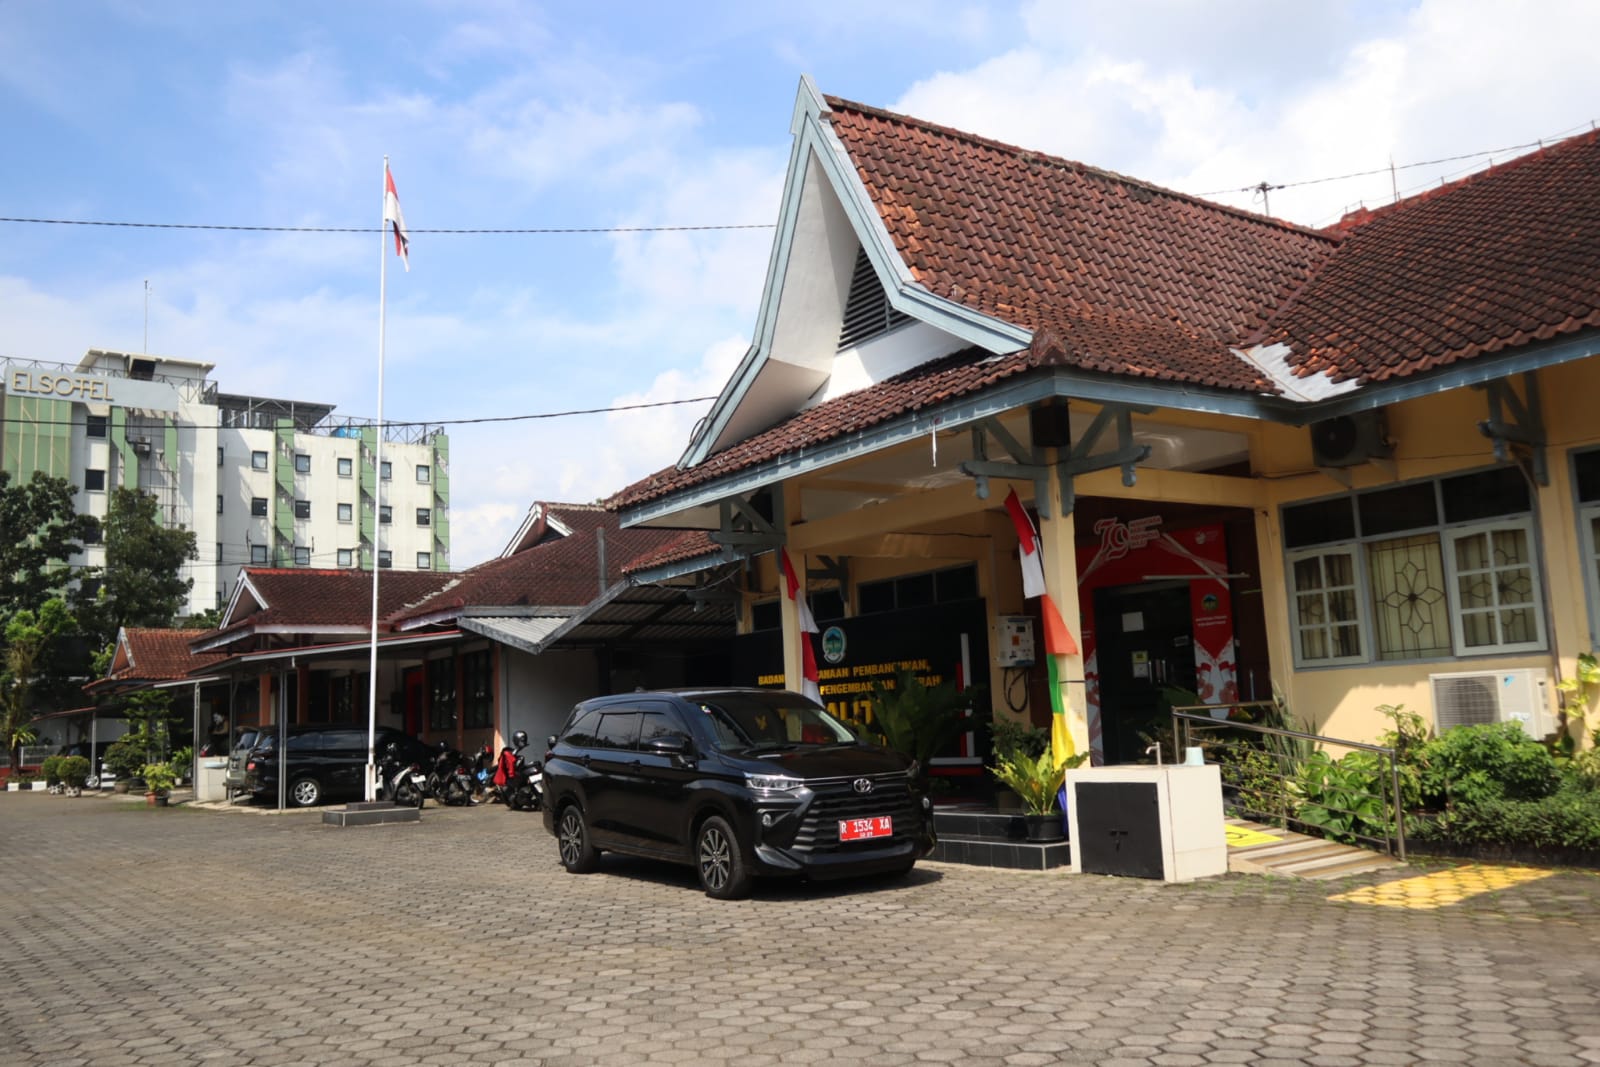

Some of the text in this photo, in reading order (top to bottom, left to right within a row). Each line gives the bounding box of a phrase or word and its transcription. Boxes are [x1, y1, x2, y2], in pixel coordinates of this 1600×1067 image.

[12, 370, 114, 400] ELSOTEL
[841, 818, 890, 834] R 1534 XA
